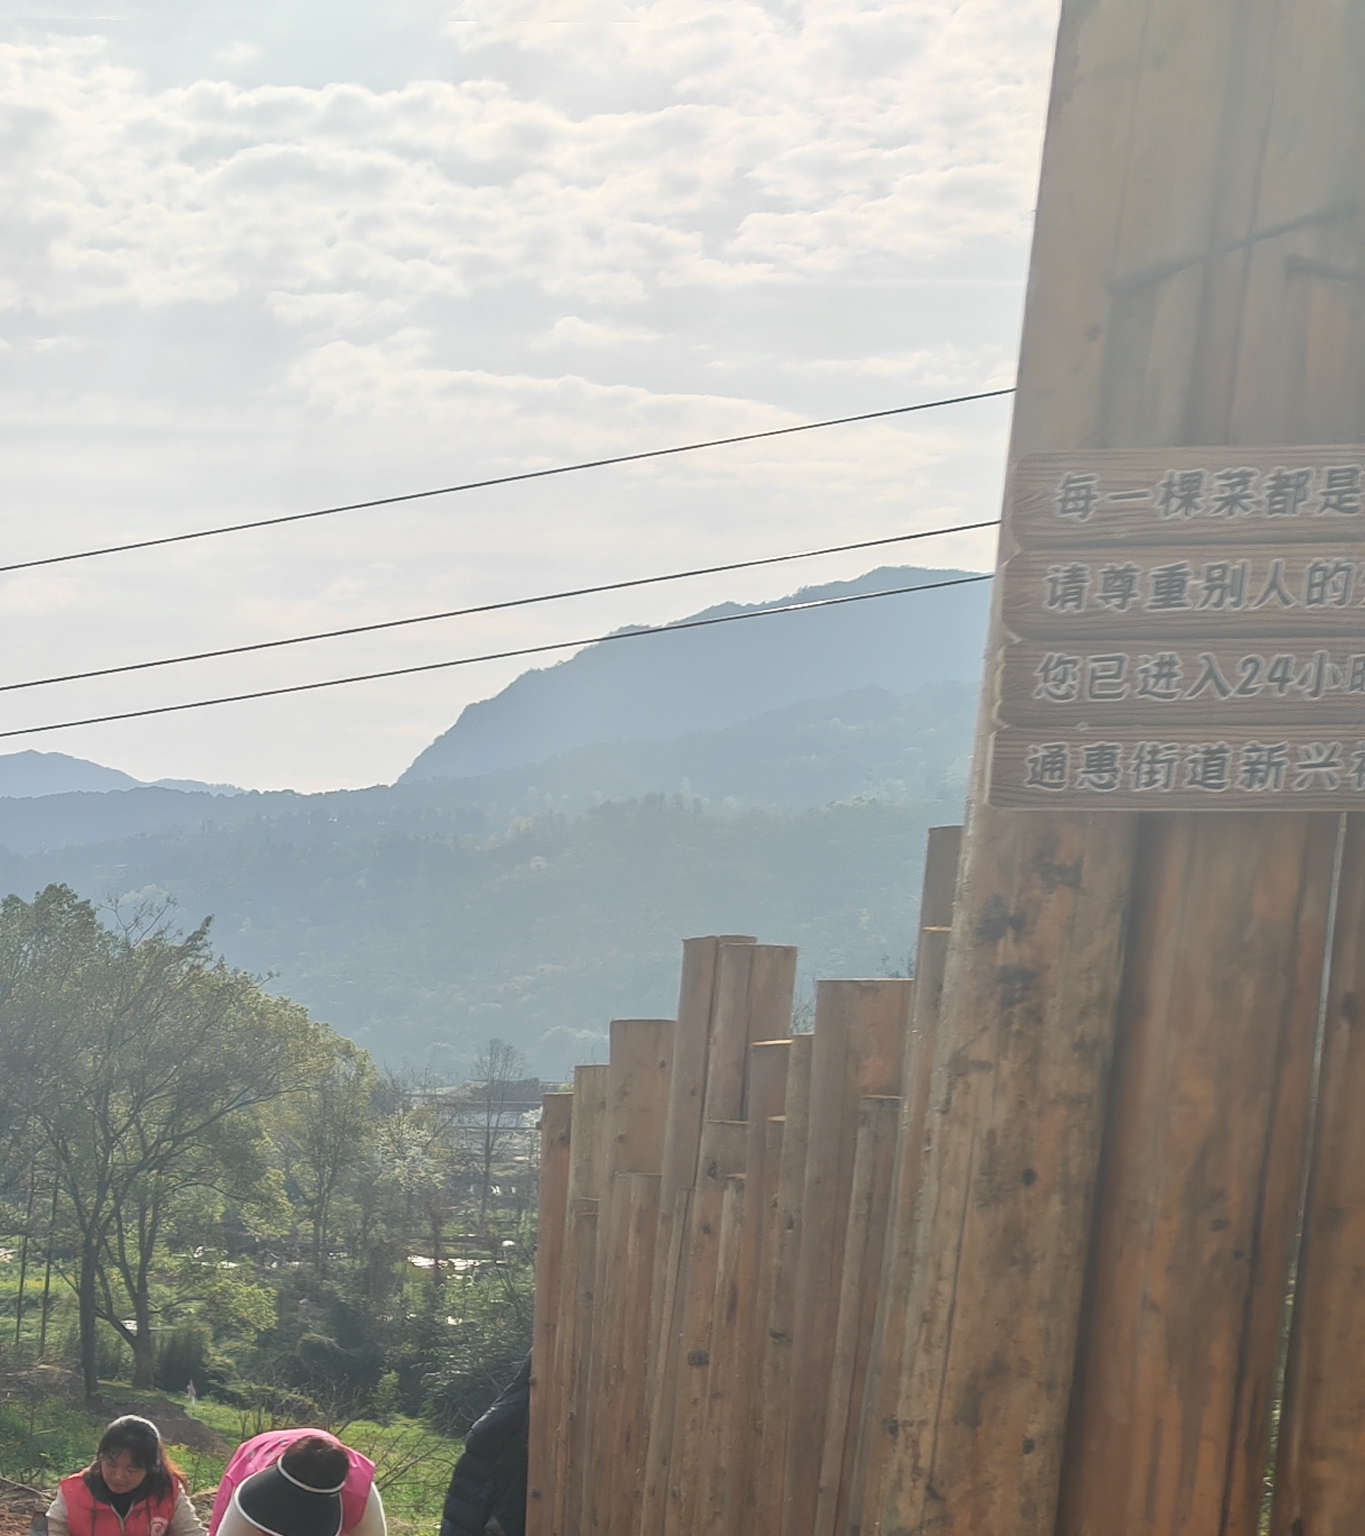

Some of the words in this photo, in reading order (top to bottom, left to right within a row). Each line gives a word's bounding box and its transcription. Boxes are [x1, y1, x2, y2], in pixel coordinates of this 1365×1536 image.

[1057, 464, 1364, 522] 每一棵菜都是
[1044, 557, 1365, 612] 请尊重别人的
